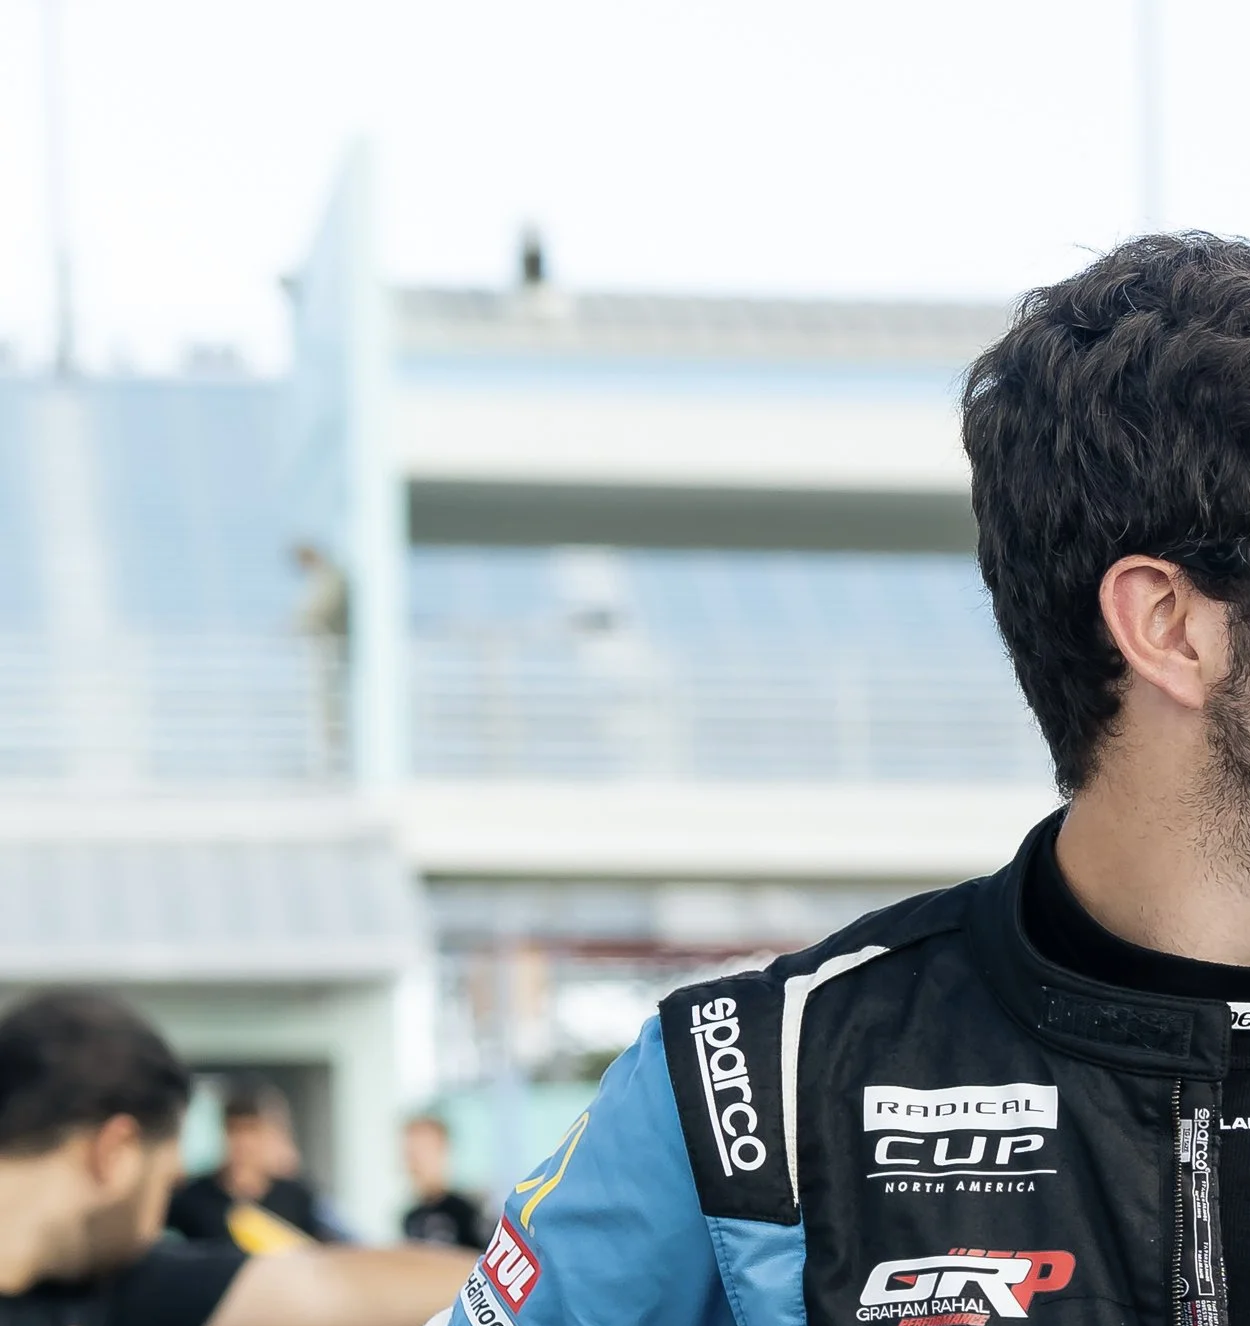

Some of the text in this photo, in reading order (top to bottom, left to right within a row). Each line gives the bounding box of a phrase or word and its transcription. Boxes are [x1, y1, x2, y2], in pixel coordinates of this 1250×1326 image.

[691, 997, 767, 1175] sparco
[876, 1099, 1045, 1118] RADICAL
[874, 1134, 1045, 1166] CUP
[884, 1180, 1036, 1194] NORTH AMERICA
[486, 1222, 537, 1304] TUL
[860, 1248, 1076, 1318] GRP
[856, 1298, 991, 1322] GRAHAM RAHAL
